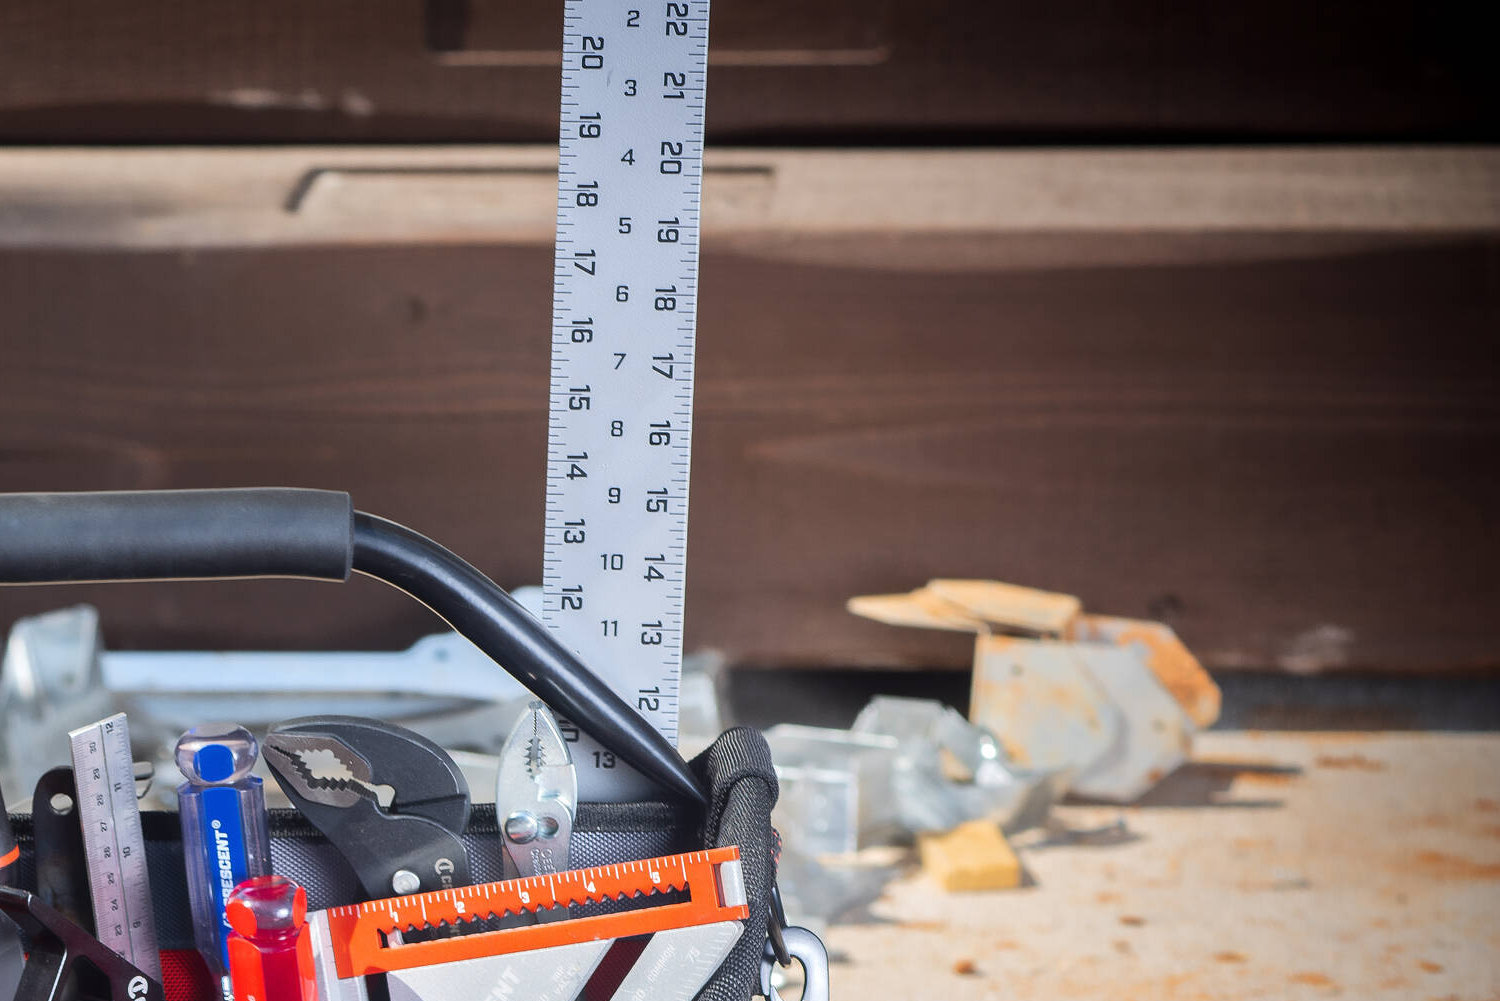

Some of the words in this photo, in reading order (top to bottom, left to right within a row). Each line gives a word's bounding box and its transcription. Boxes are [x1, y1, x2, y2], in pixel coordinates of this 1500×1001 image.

[626, 10, 640, 28] 2
[665, 2, 689, 36] 22
[581, 36, 604, 69] 20
[624, 79, 637, 96] 3
[663, 72, 686, 99] 21
[579, 112, 601, 138] 19
[620, 149, 635, 165] 4
[660, 141, 683, 174] 20
[576, 180, 598, 207] 18
[618, 217, 632, 234] 5
[657, 216, 679, 243] 19
[574, 249, 596, 275] 17
[616, 285, 629, 302] 6
[654, 285, 677, 311] 18
[571, 317, 593, 343] 16
[613, 353, 626, 370] 7
[652, 353, 674, 379] 17
[568, 385, 591, 410] 15
[610, 420, 623, 437] 8
[649, 420, 671, 446] 16
[566, 452, 588, 480] 14
[608, 487, 621, 504] 9
[646, 487, 668, 512] 15
[564, 519, 585, 543] 13
[600, 553, 624, 570] 10
[643, 554, 665, 582] 14
[561, 585, 583, 610] 12
[601, 620, 618, 637] 11
[641, 620, 662, 645] 13
[638, 686, 660, 711] 12
[105, 721, 114, 734] 12
[592, 751, 616, 769] 13
[587, 881, 596, 893] 4
[652, 872, 661, 883] 5
[457, 901, 466, 913] 2
[522, 892, 530, 903] 3
